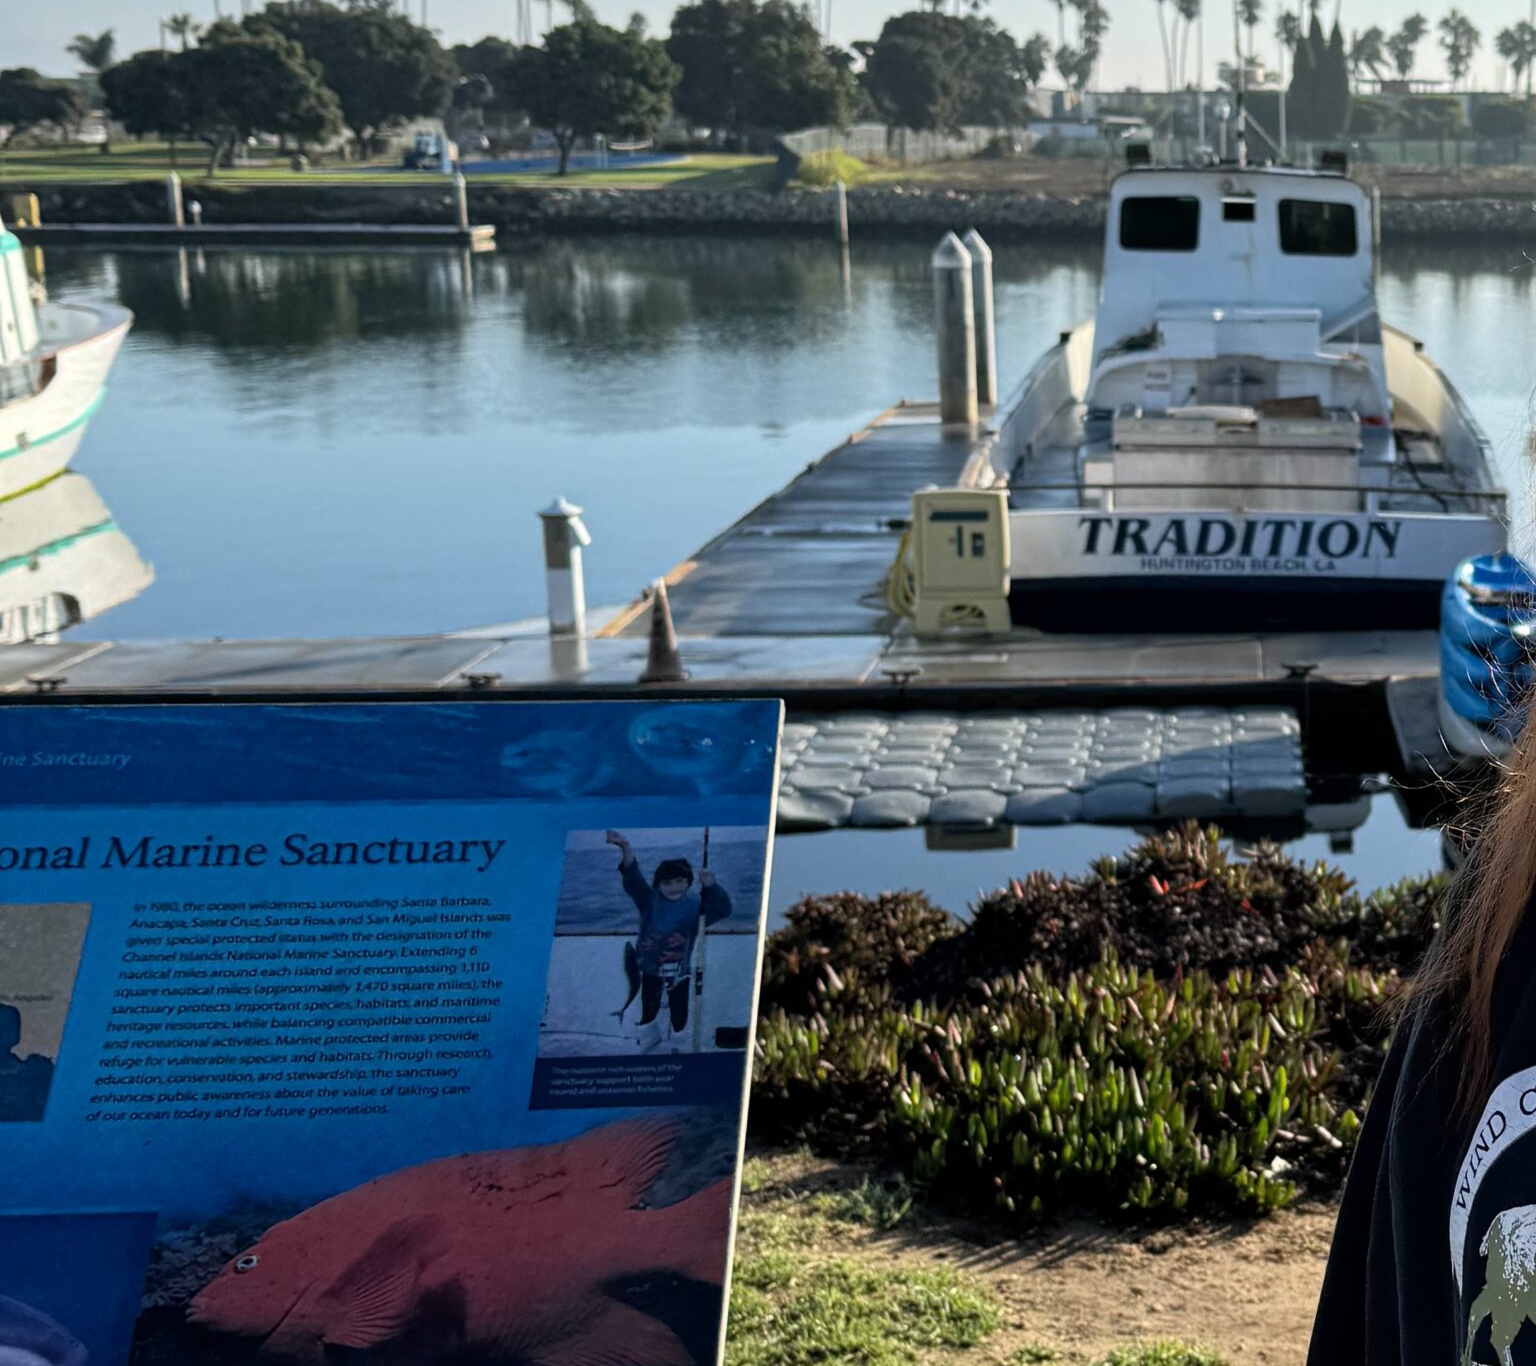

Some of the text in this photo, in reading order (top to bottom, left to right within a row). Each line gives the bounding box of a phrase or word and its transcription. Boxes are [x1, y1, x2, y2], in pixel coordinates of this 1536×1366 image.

[1078, 517, 1404, 559] TRADITION
[1140, 558, 1246, 572] HUNTINGTON
[1314, 559, 1336, 572] CA
[32, 751, 132, 771] Sanctuary
[0, 832, 507, 872] onal Marine Sanctuary
[207, 902, 245, 910] ocean
[319, 899, 398, 910] surrounding
[402, 898, 437, 907] Santa
[191, 918, 228, 927] Santa
[265, 917, 300, 926] Santa
[366, 915, 389, 924] San
[393, 914, 437, 925] Miguel
[440, 913, 484, 923] Islands
[165, 935, 209, 947] special
[212, 934, 276, 945] protected
[352, 931, 373, 941] the
[376, 930, 451, 941] designation
[455, 930, 468, 939] of
[471, 929, 493, 939] the
[122, 952, 176, 963] Channel
[179, 951, 224, 961] Islands
[227, 950, 281, 961] National
[284, 949, 328, 959] Marine
[400, 947, 465, 958] Extending
[118, 969, 170, 980] nautical
[173, 969, 208, 978] miles
[211, 968, 258, 977] around
[260, 967, 291, 977] each
[295, 965, 332, 976] island
[335, 965, 360, 975] and
[363, 963, 457, 976] encompassing
[161, 986, 214, 996] nautical
[217, 985, 250, 995] miles
[391, 981, 434, 993] square
[481, 979, 503, 989] the
[112, 1006, 174, 1018] sanctuary
[177, 1004, 230, 1016] protects
[235, 1002, 301, 1014] important
[413, 997, 439, 1008] and
[441, 996, 500, 1007] maritime
[107, 1022, 161, 1033] heritage
[232, 1020, 267, 1029] while
[271, 1016, 334, 1029] balancing
[338, 1014, 413, 1027] compatible
[415, 1012, 491, 1024] commercial
[103, 1039, 129, 1049] and
[131, 1038, 209, 1049] recreational
[275, 1033, 321, 1045] Marine
[324, 1032, 388, 1046] protected
[429, 1031, 479, 1043] provide
[99, 1057, 143, 1069] refuge
[144, 1056, 163, 1066] for
[167, 1055, 237, 1066] vulnerable
[240, 1055, 287, 1066] species
[290, 1051, 317, 1062] and
[378, 1049, 433, 1062] Through
[258, 1071, 283, 1082] and
[370, 1068, 392, 1077] the
[396, 1067, 460, 1079] sanctuary
[90, 1084, 470, 1104] enhances public awareness about the value of taking care
[85, 1110, 99, 1121] of
[103, 1111, 125, 1120] our
[129, 1110, 170, 1120] ocean
[173, 1108, 210, 1121] today
[215, 1107, 240, 1119] and
[243, 1106, 262, 1118] for
[264, 1105, 305, 1116] future
[1456, 1109, 1508, 1212] WIND
